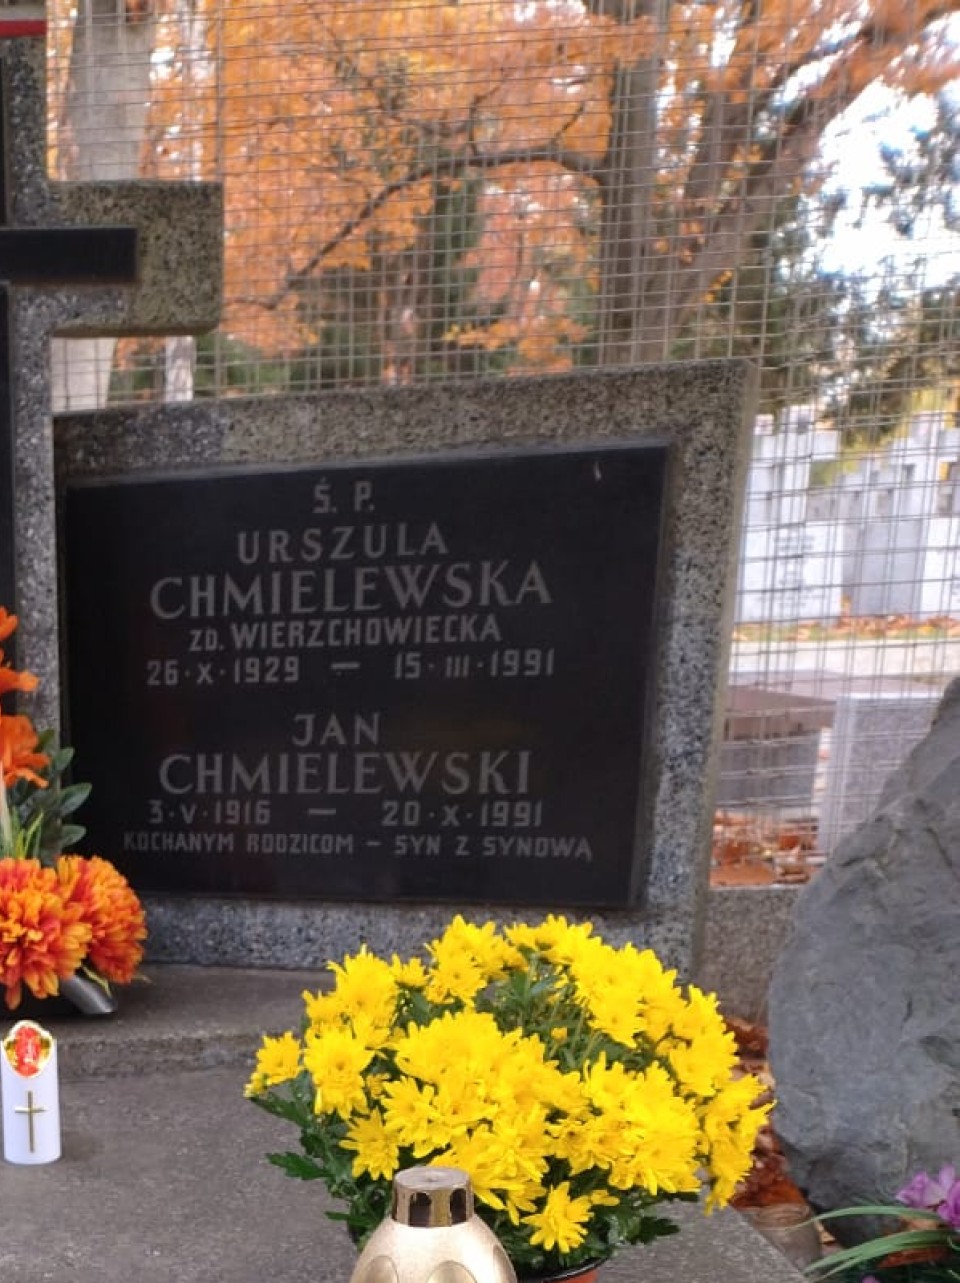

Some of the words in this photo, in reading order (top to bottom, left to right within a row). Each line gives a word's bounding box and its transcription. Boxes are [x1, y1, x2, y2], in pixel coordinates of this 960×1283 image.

[355, 481, 374, 512] P.
[239, 521, 448, 564] URSZULA
[149, 560, 552, 620] CHMIELEWSKA
[189, 629, 224, 653] ZD.
[230, 614, 502, 650] WIERZCHOWIECKA
[292, 713, 380, 746] JAN
[159, 750, 531, 795] CHMIELEWSKI
[123, 831, 234, 853] KOCHANYM
[247, 833, 354, 854] RODZICOM
[394, 835, 440, 856] SYN
[455, 836, 470, 856] Z
[482, 836, 592, 862] SYNOWĄ
